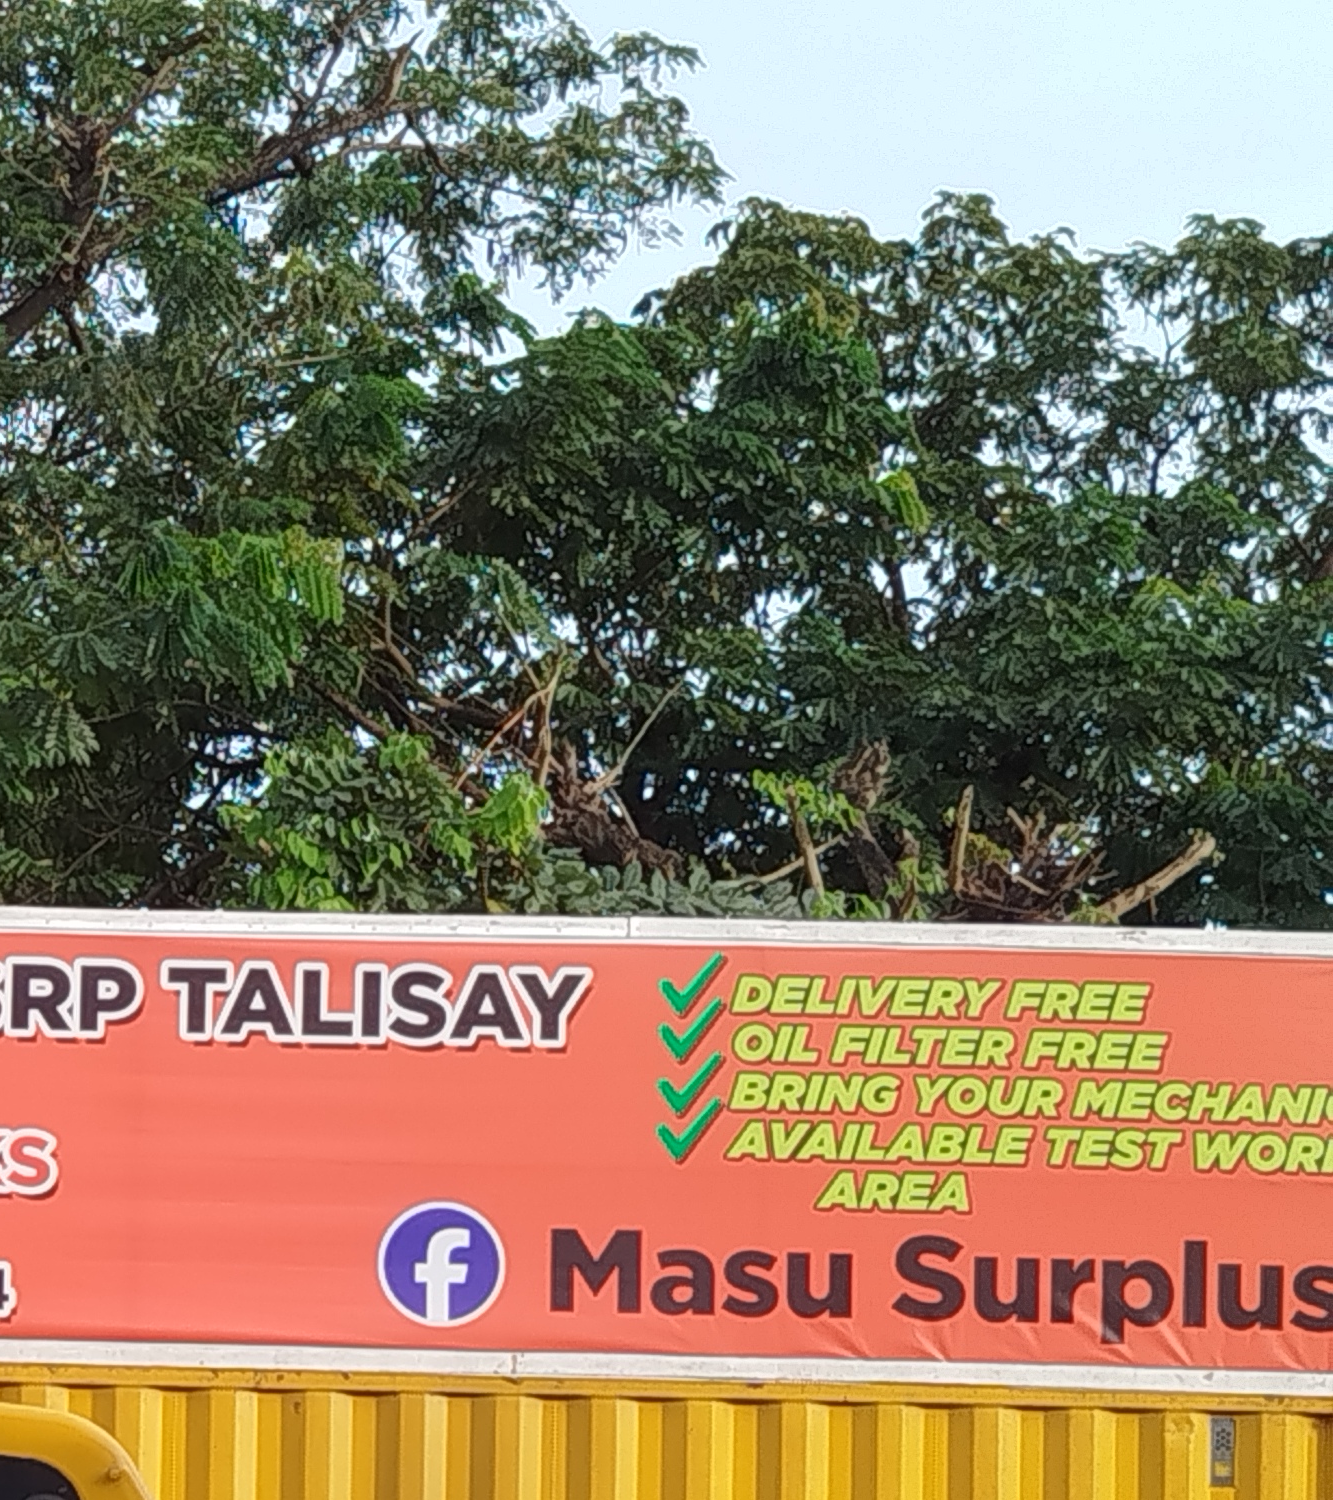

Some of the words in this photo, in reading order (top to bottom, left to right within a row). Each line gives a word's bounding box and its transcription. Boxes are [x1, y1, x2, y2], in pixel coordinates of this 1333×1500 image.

[166, 966, 588, 1042] TALISAY
[732, 976, 997, 1018] DELIVERY
[1006, 982, 1150, 1021] FREE
[732, 1024, 819, 1064] OIL
[831, 1027, 1015, 1067] FILTER
[1023, 1032, 1166, 1071] FREE
[729, 1073, 899, 1114] BRING
[916, 1077, 1059, 1117] YOUR
[1072, 1080, 1333, 1124] MECHANI
[728, 1121, 1033, 1164] AVAILABLE
[1046, 1128, 1181, 1169] TEST
[814, 1171, 971, 1213] AREA
[550, 1228, 853, 1318] Masu
[891, 1235, 1333, 1344] Surplus
